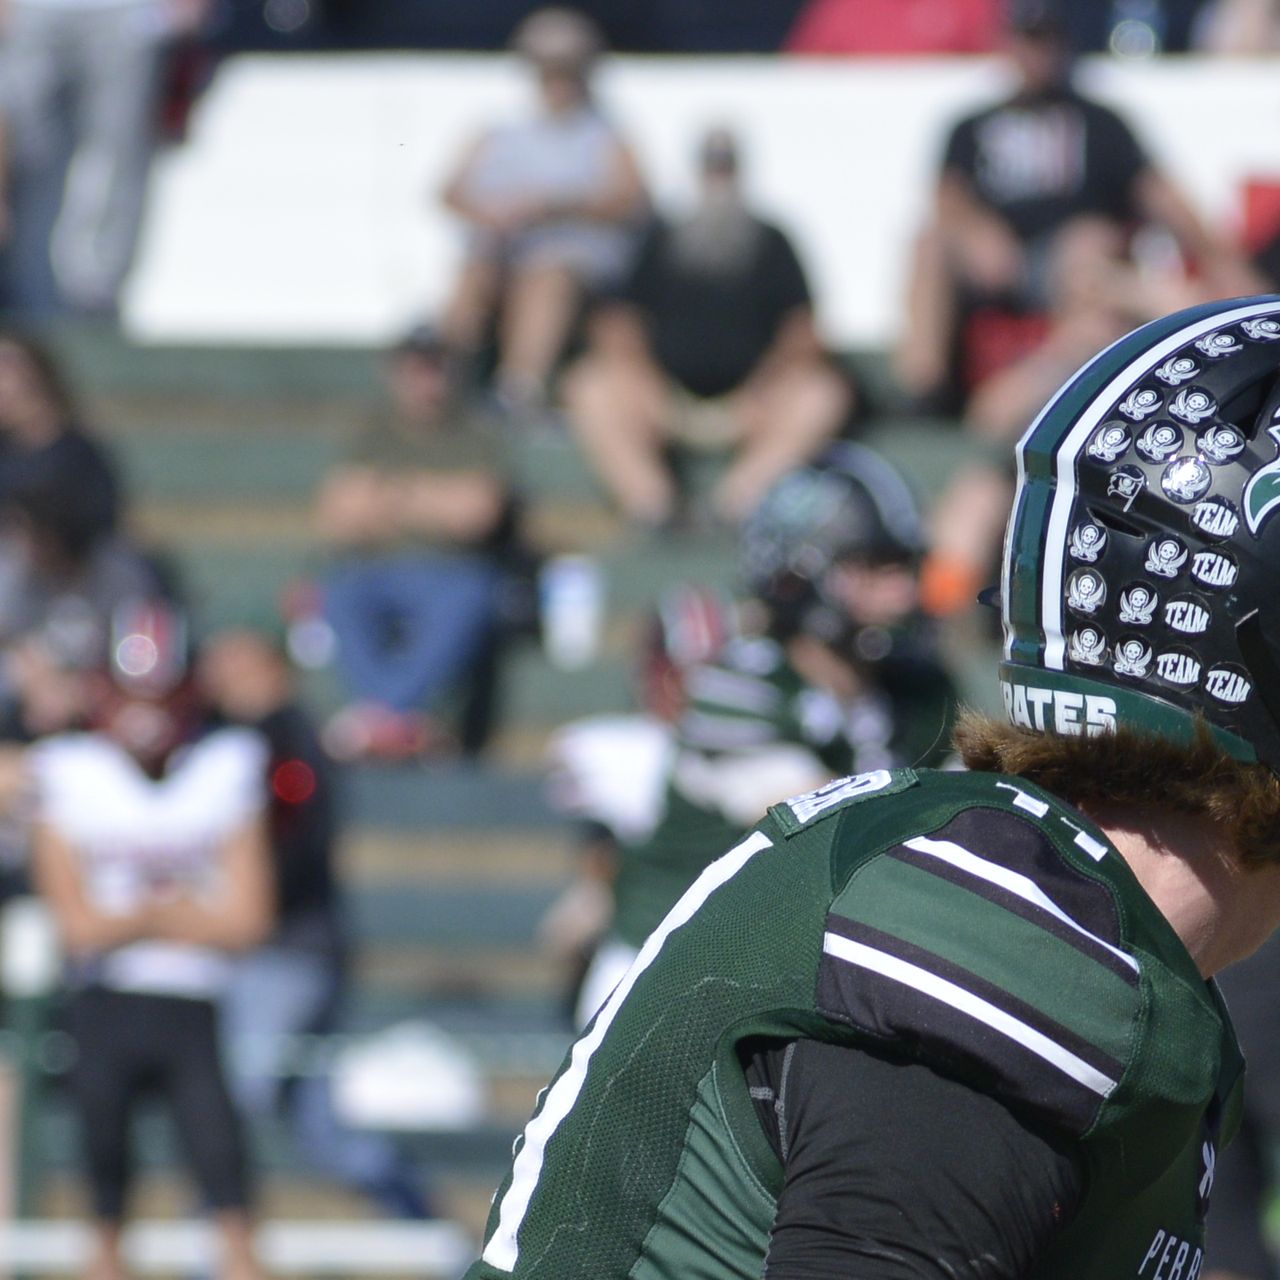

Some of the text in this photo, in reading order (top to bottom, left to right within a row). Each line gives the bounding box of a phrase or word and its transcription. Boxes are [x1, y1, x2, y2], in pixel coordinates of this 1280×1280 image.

[1193, 502, 1239, 536] TEAM
[1191, 552, 1237, 586] TEAM
[1165, 601, 1210, 633] TEAM
[1157, 653, 1201, 684] TEAM
[1205, 670, 1251, 703] TEAM
